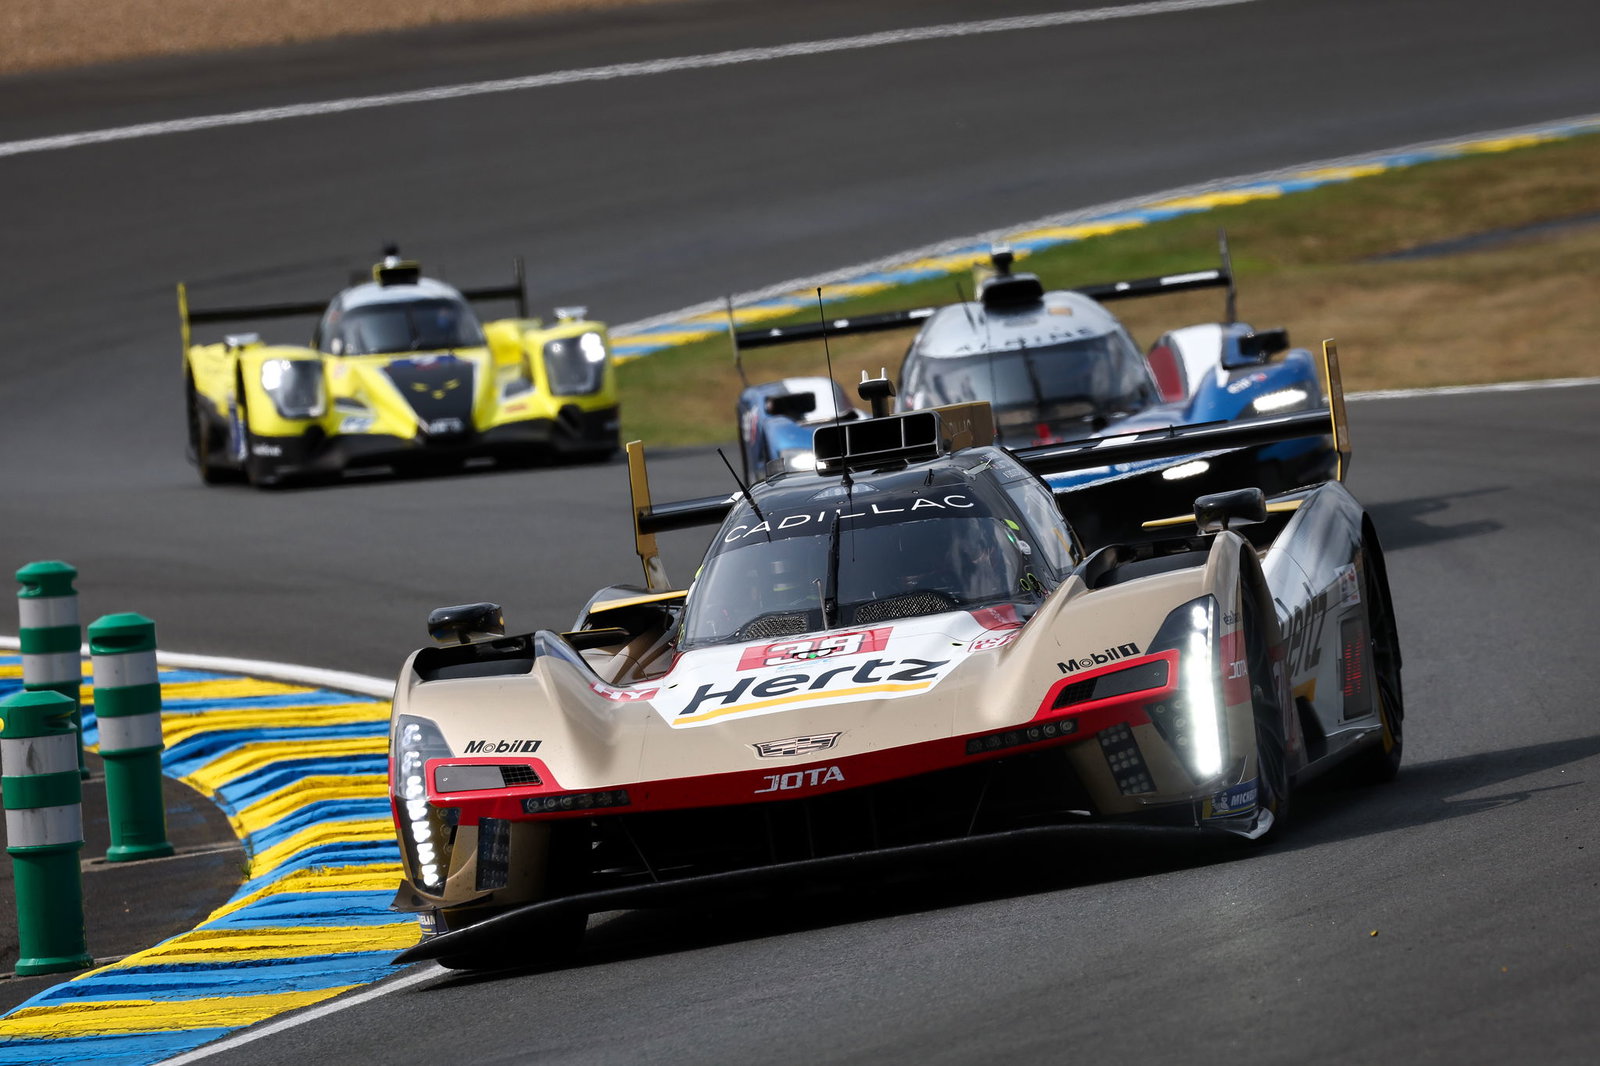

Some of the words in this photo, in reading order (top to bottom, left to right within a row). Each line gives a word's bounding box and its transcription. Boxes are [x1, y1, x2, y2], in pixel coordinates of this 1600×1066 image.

[725, 495, 975, 543] CADILLAC
[1057, 645, 1121, 674] Mobil
[593, 683, 655, 700] HY
[679, 658, 949, 715] Hertz
[464, 740, 523, 754] Mobil
[755, 766, 845, 794] JOTA
